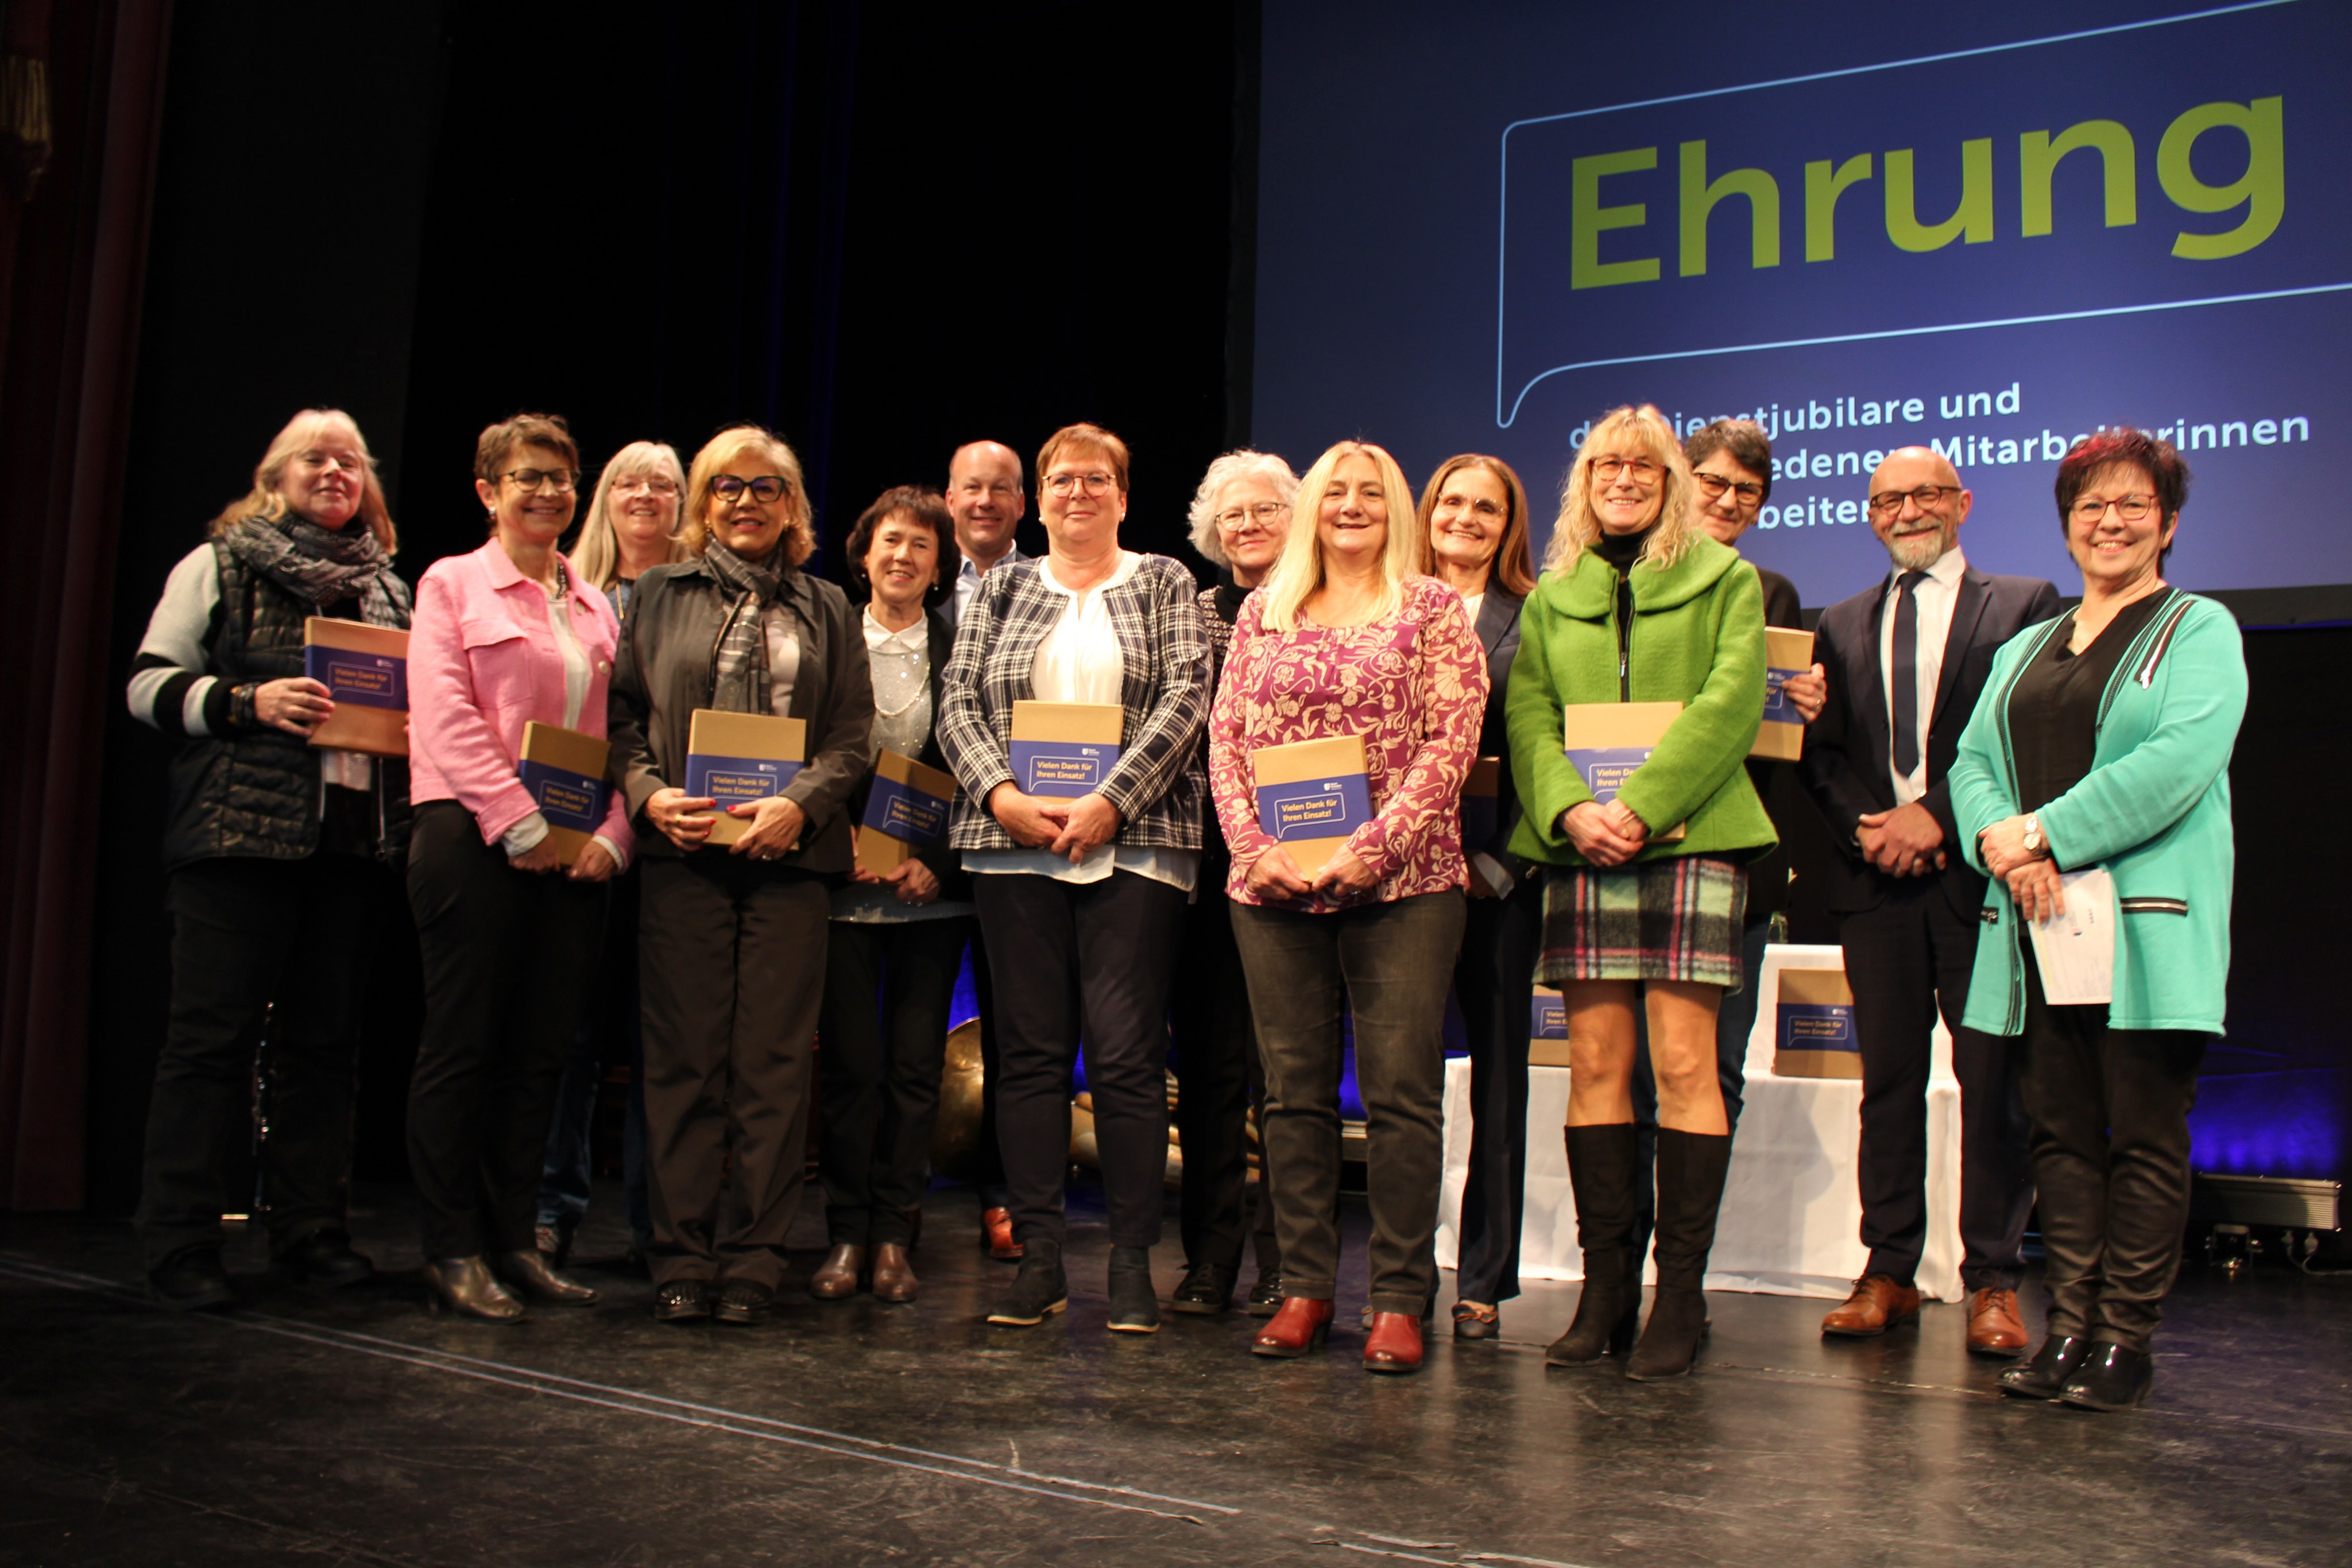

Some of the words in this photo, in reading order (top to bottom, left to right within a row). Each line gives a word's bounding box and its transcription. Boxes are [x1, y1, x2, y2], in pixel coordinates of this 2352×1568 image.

[1572, 95, 2285, 288] Ehrung
[1940, 381, 2021, 420] und
[1036, 761, 1060, 769] Vielen
[1061, 762, 1081, 771] Dank
[1081, 762, 1093, 771] für
[1036, 770, 1057, 779] Ihren
[1057, 771, 1085, 780] Einsatz!
[1596, 768, 1622, 777] Vielen
[1597, 778, 1619, 787] Ihren
[1281, 804, 1305, 812] Vielen
[1305, 800, 1326, 810] Dank
[1326, 799, 1338, 807] für
[1282, 814, 1303, 822] Ihren
[1303, 809, 1332, 820] Einsatz!
